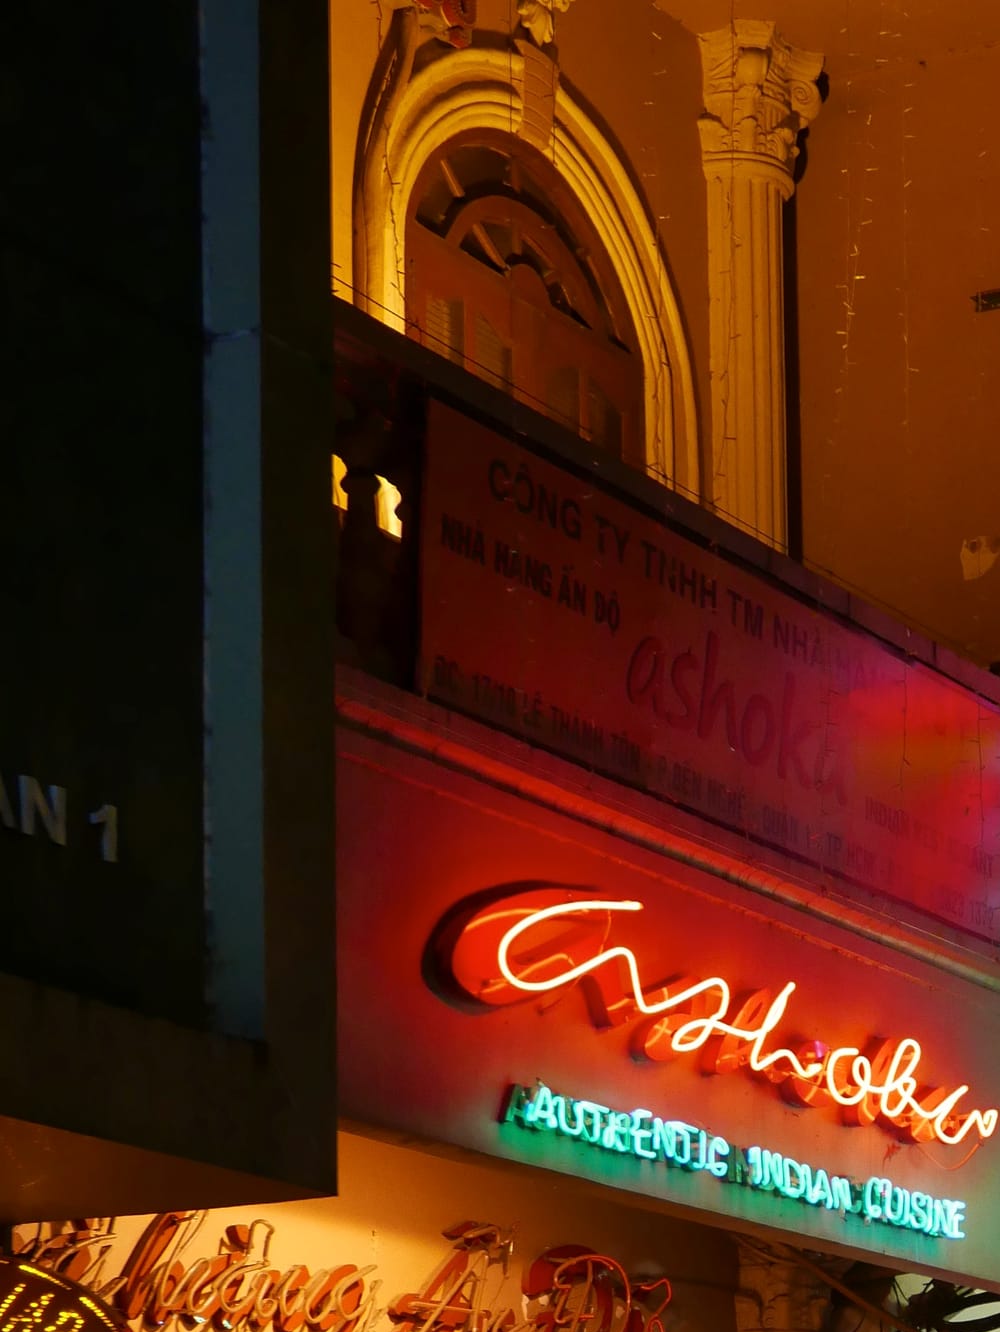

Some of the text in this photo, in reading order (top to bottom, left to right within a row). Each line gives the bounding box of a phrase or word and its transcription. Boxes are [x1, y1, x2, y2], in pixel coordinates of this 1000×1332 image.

[487, 458, 583, 541] CÔNG
[594, 512, 631, 564] TY
[640, 538, 718, 610] TNHH
[727, 587, 764, 641] TM
[0, 768, 119, 864] N 1
[738, 1146, 852, 1211] INDIAN
[862, 1176, 967, 1240] CUISINE
